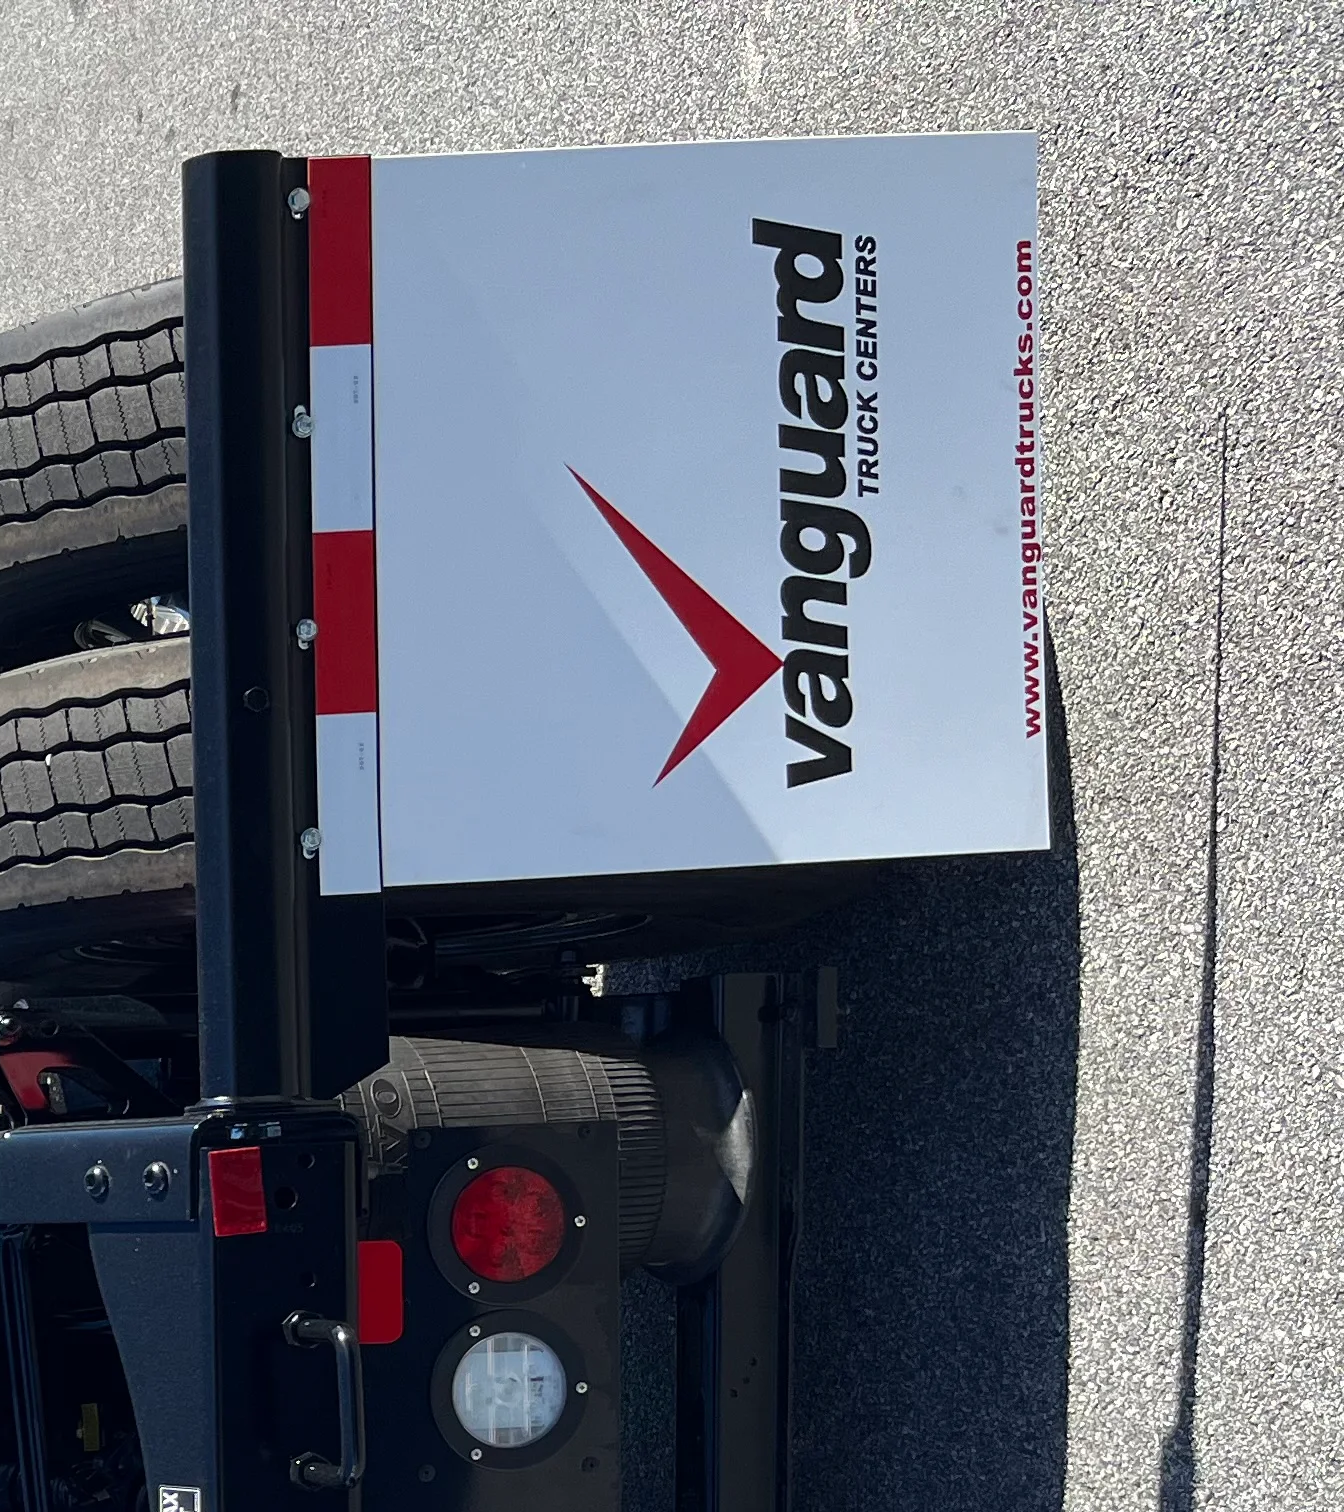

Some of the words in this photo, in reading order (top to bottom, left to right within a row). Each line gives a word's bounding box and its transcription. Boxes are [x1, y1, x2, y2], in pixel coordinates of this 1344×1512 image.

[854, 234, 878, 381] CENTERS
[856, 390, 880, 498] TRUCK
[752, 217, 872, 789] vanguard
[1013, 240, 1042, 738] www.vanguardtrucks.com
